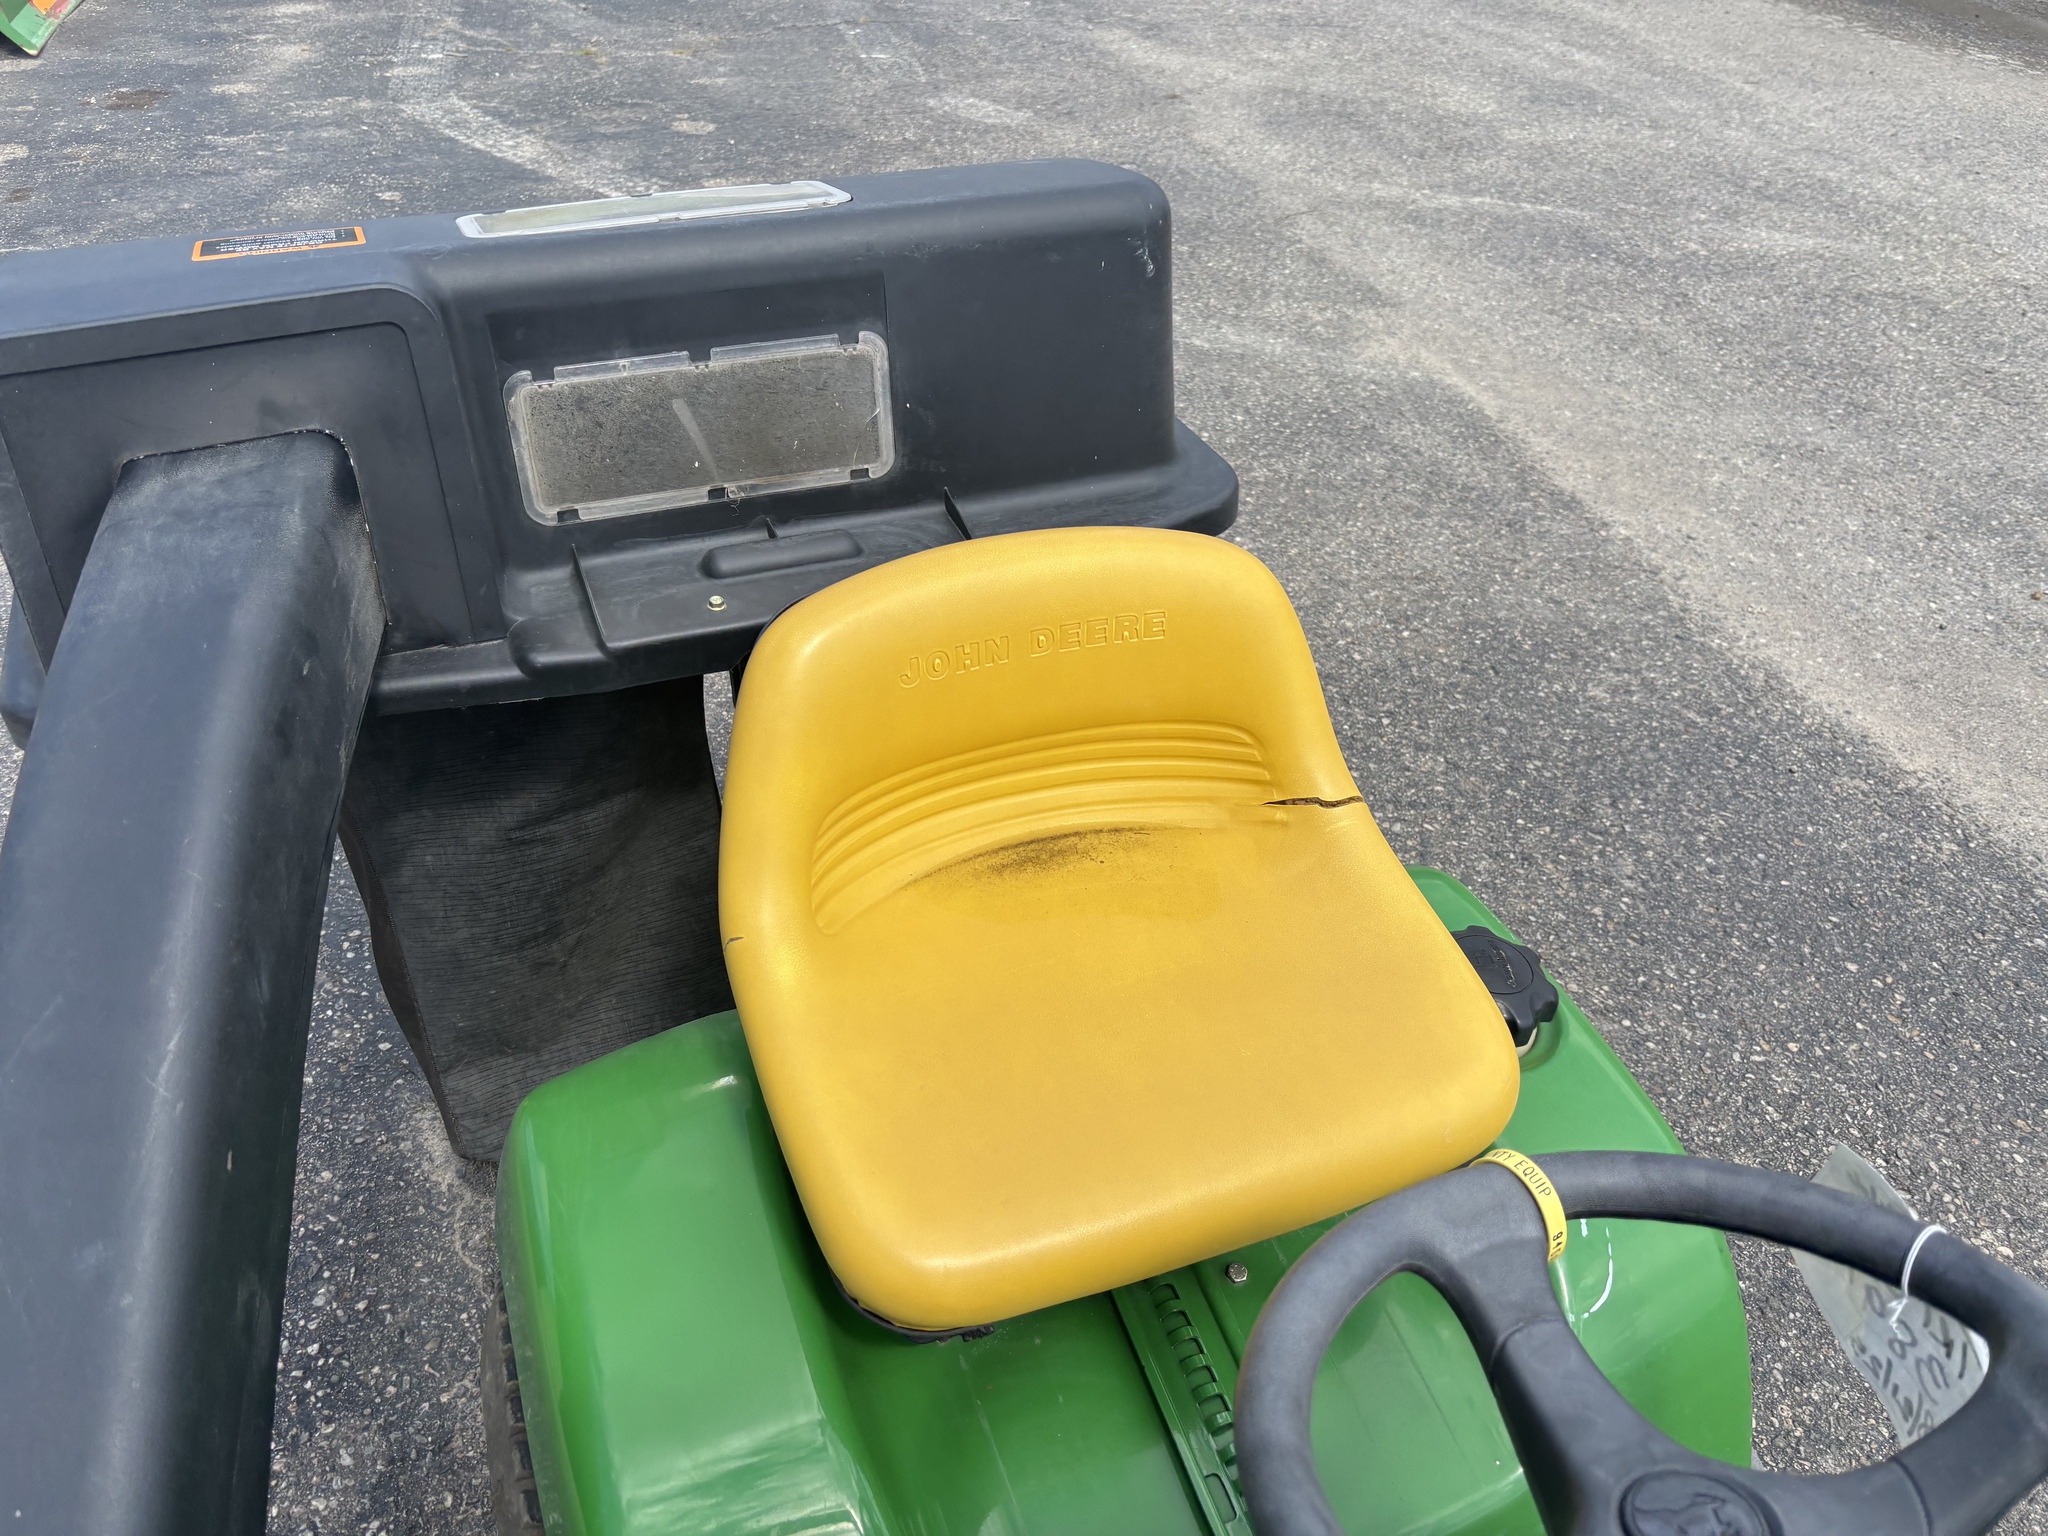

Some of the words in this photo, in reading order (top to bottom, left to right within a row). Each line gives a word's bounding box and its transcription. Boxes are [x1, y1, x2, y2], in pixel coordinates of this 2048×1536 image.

[899, 635, 1010, 689] JOHN
[1028, 610, 1167, 657] DEERE
[1514, 1159, 1552, 1196] EQUIP
